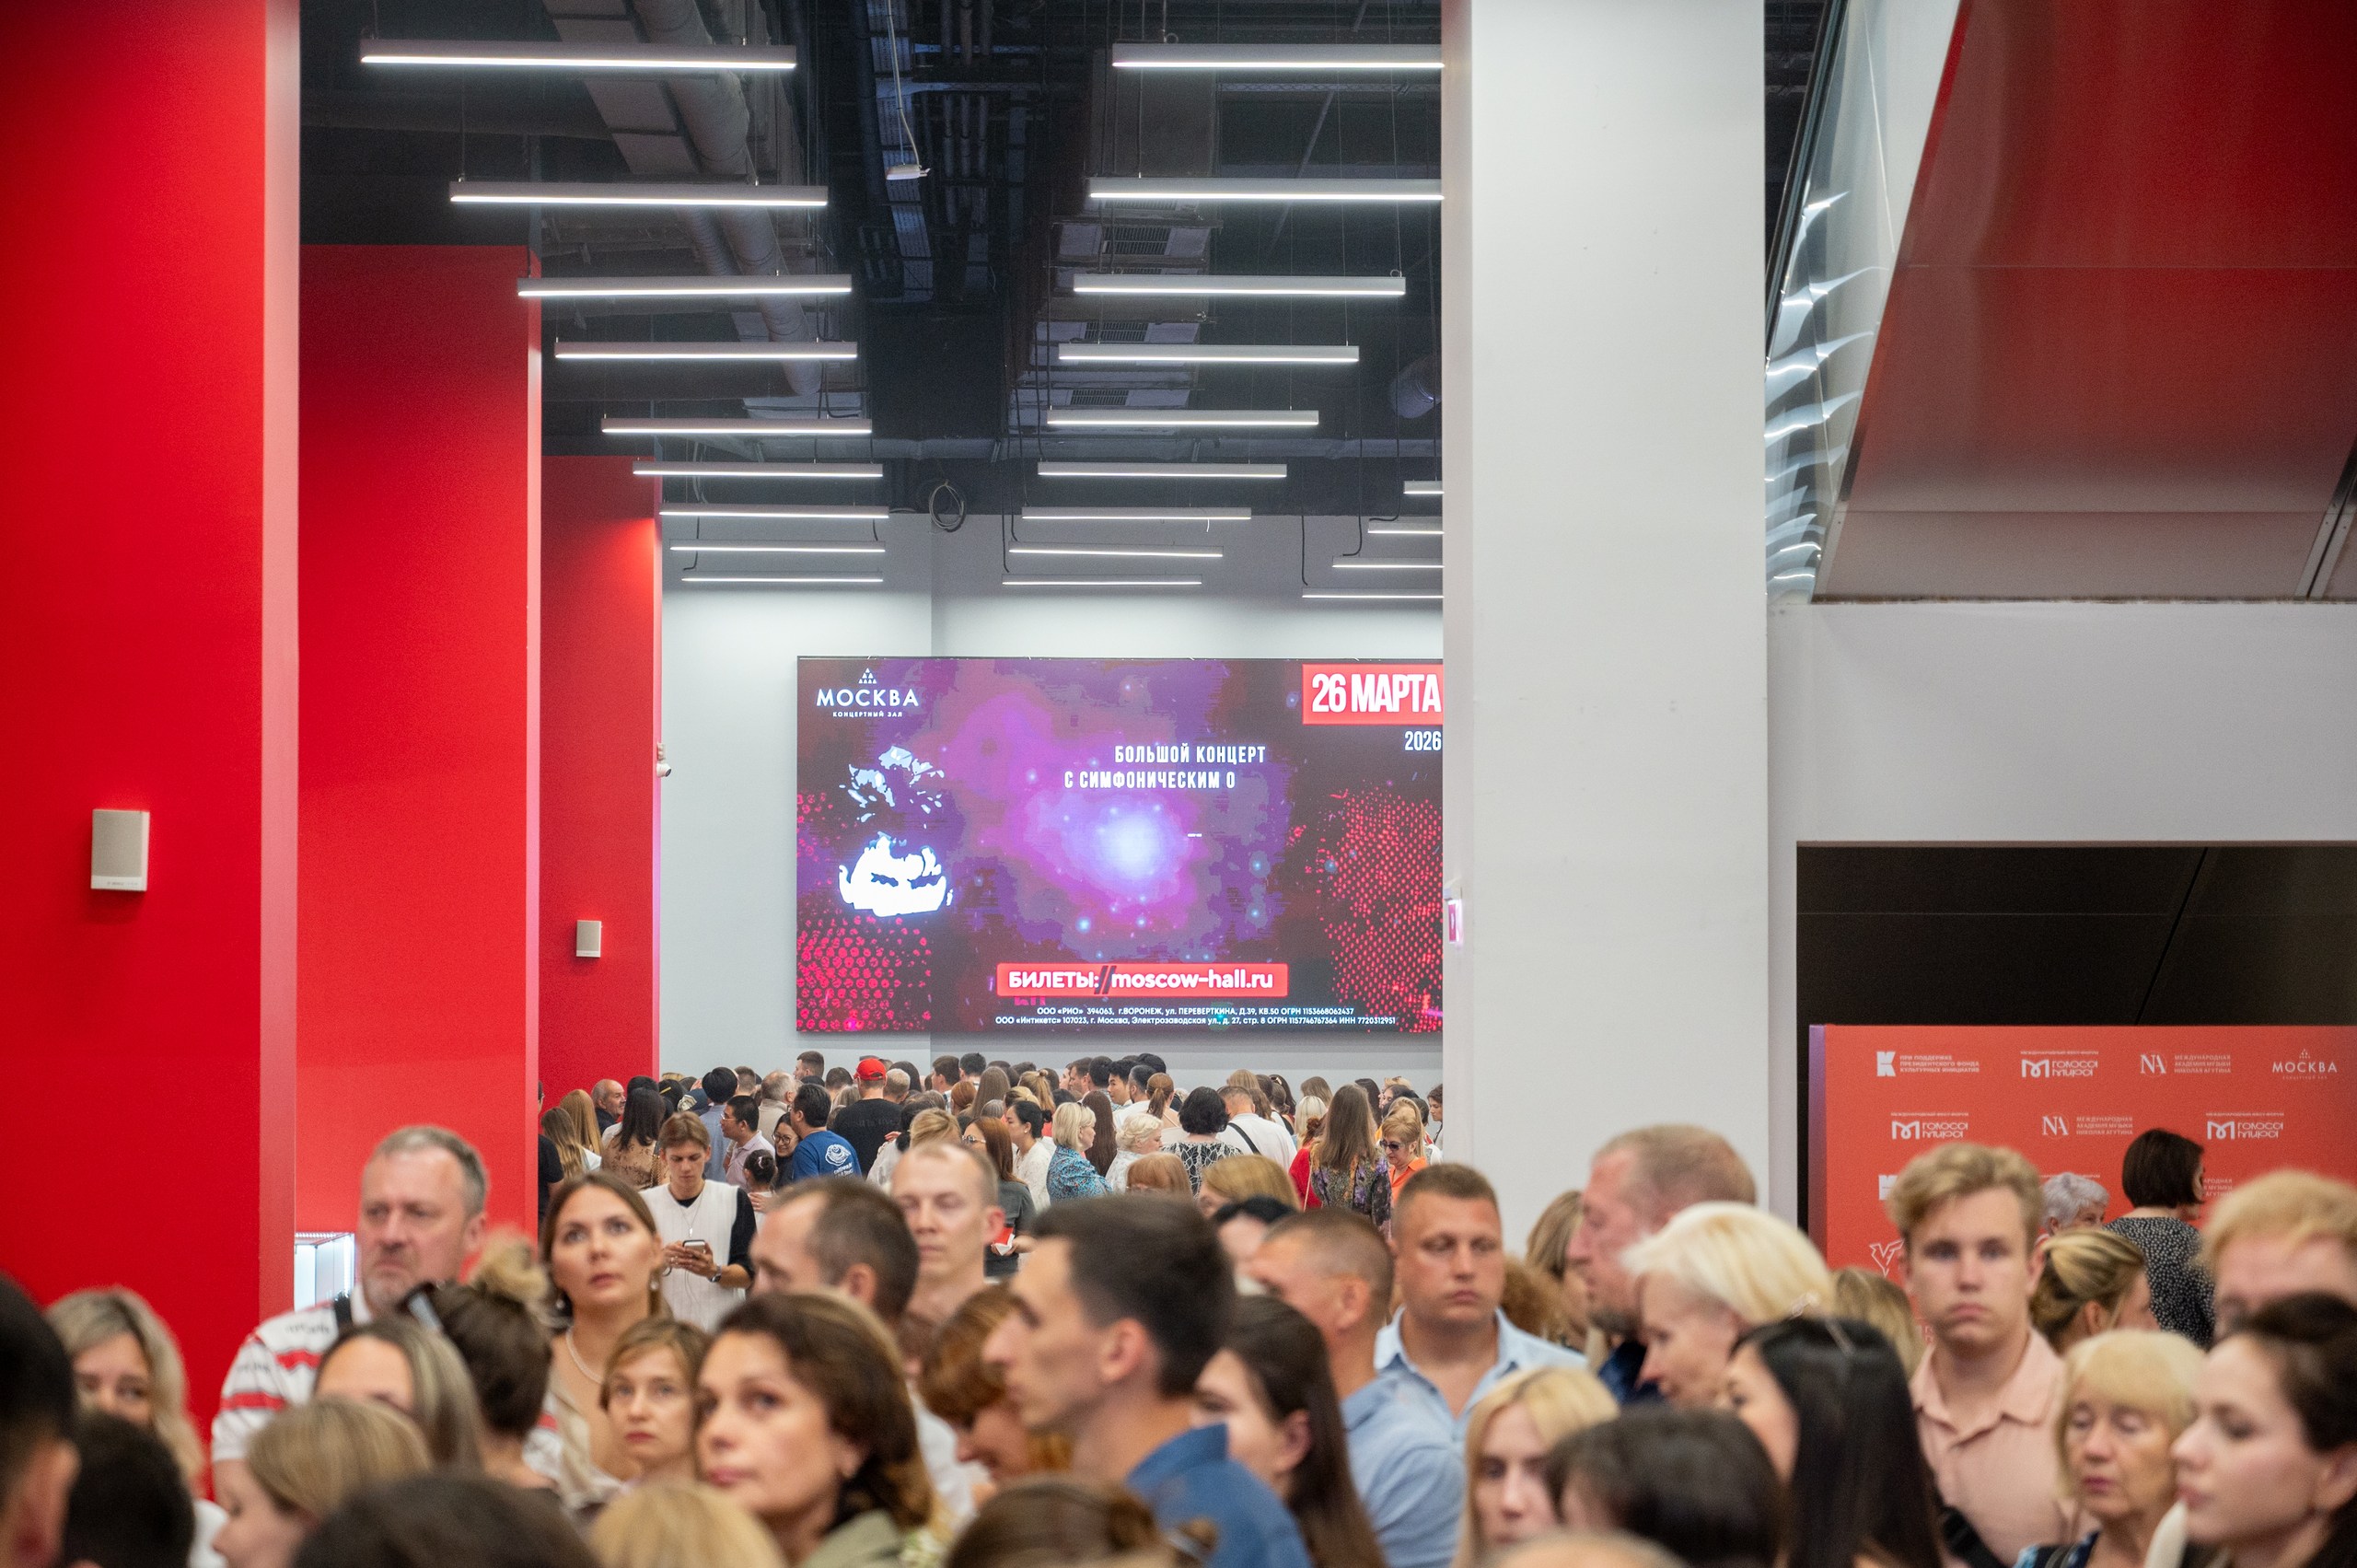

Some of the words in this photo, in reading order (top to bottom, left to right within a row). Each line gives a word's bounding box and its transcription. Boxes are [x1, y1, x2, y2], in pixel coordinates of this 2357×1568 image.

[816, 689, 919, 707] МОСКВА
[1312, 673, 1347, 713] 26
[1351, 673, 1442, 713] МАРТА
[1404, 730, 1442, 751] 2026
[1114, 743, 1190, 763] БОЛЬШОЙ
[1196, 746, 1266, 765] КОНЦЕРТ
[1064, 771, 1074, 789] С
[1079, 771, 1220, 789] СИМФОНИЧЕСКИМ
[1226, 771, 1236, 789] О
[1062, 1016, 1089, 1025] 107023,
[1097, 1016, 1131, 1025] Москва,
[1132, 1016, 1206, 1025] Электрозаводская
[1178, 1007, 1237, 1016] ПЕРЕВЕРТКИНА,
[2271, 1061, 2338, 1074] МОСКВА
